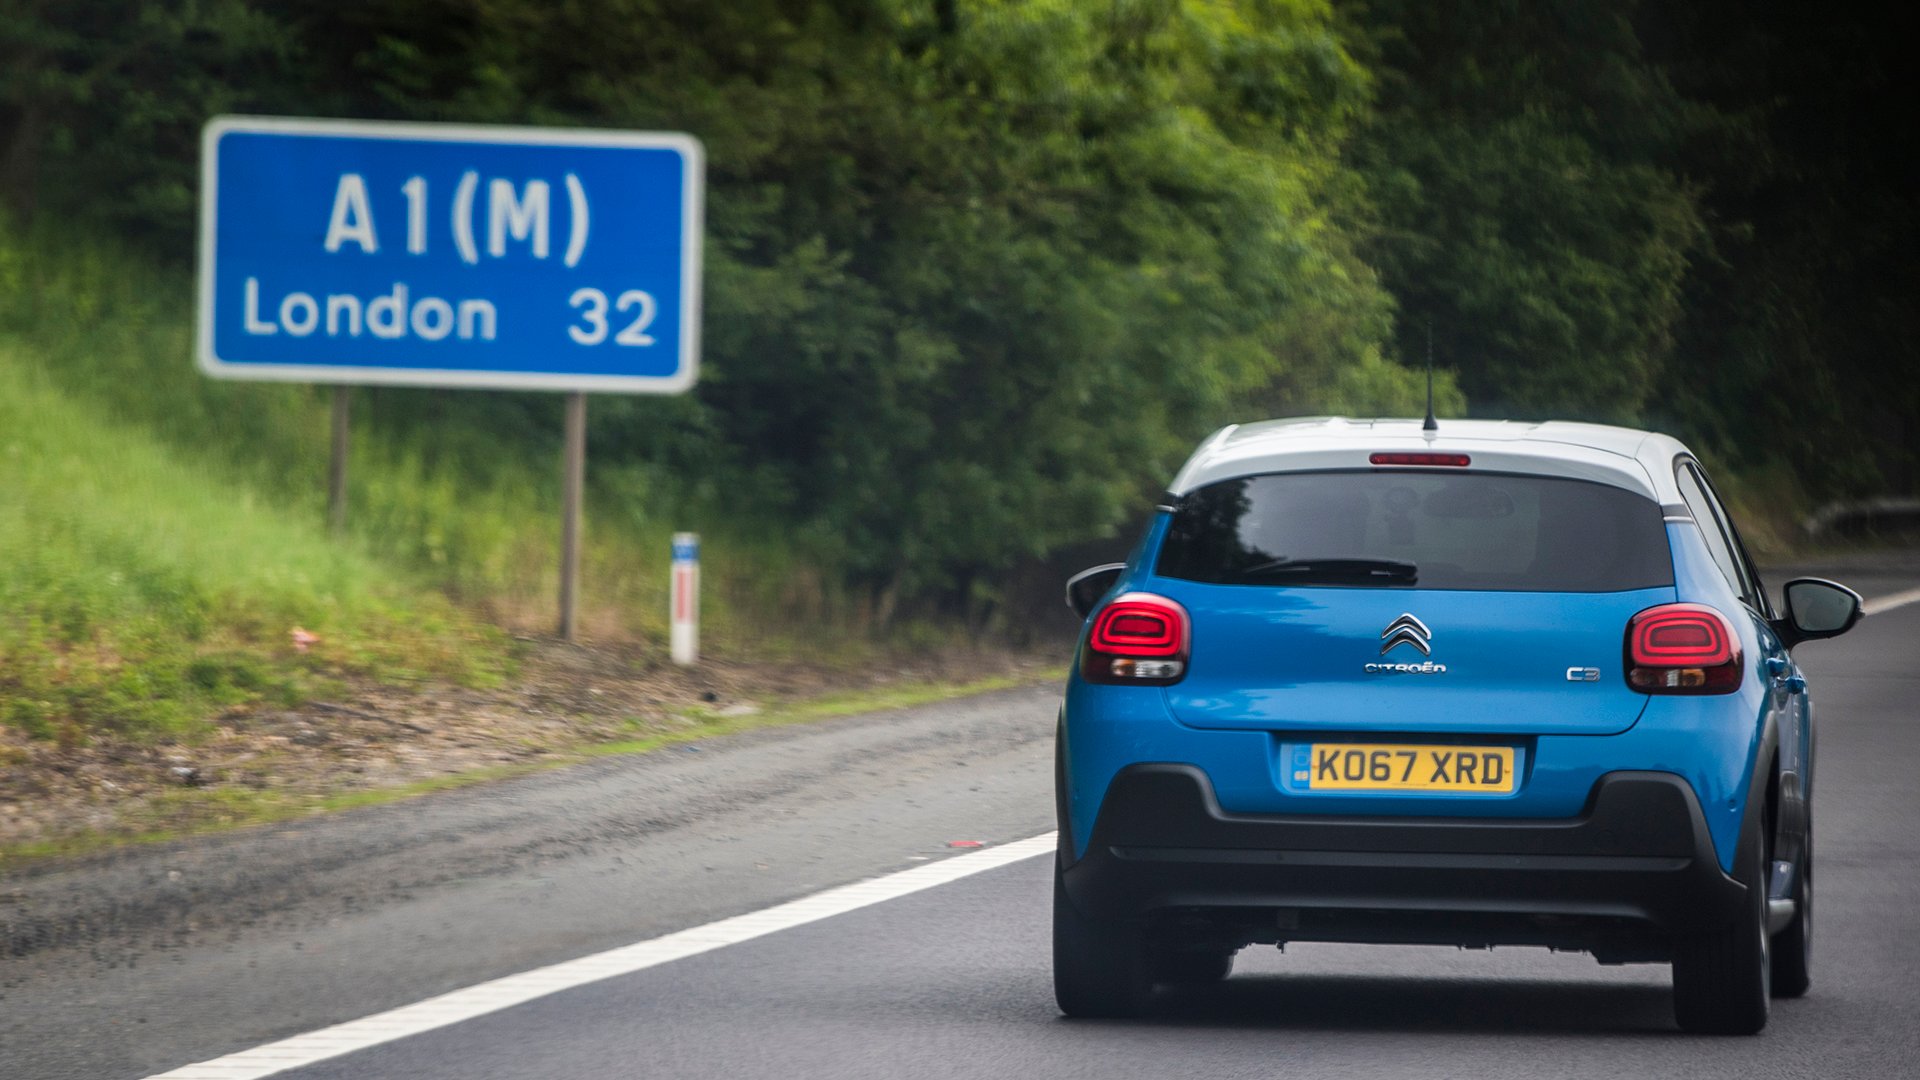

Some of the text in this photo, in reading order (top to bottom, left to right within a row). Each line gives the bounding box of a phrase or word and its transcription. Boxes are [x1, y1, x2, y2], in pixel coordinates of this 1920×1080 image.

[244, 277, 657, 347] London 32
[1566, 666, 1600, 682] C3
[1317, 750, 1504, 784] KO67 XRD
